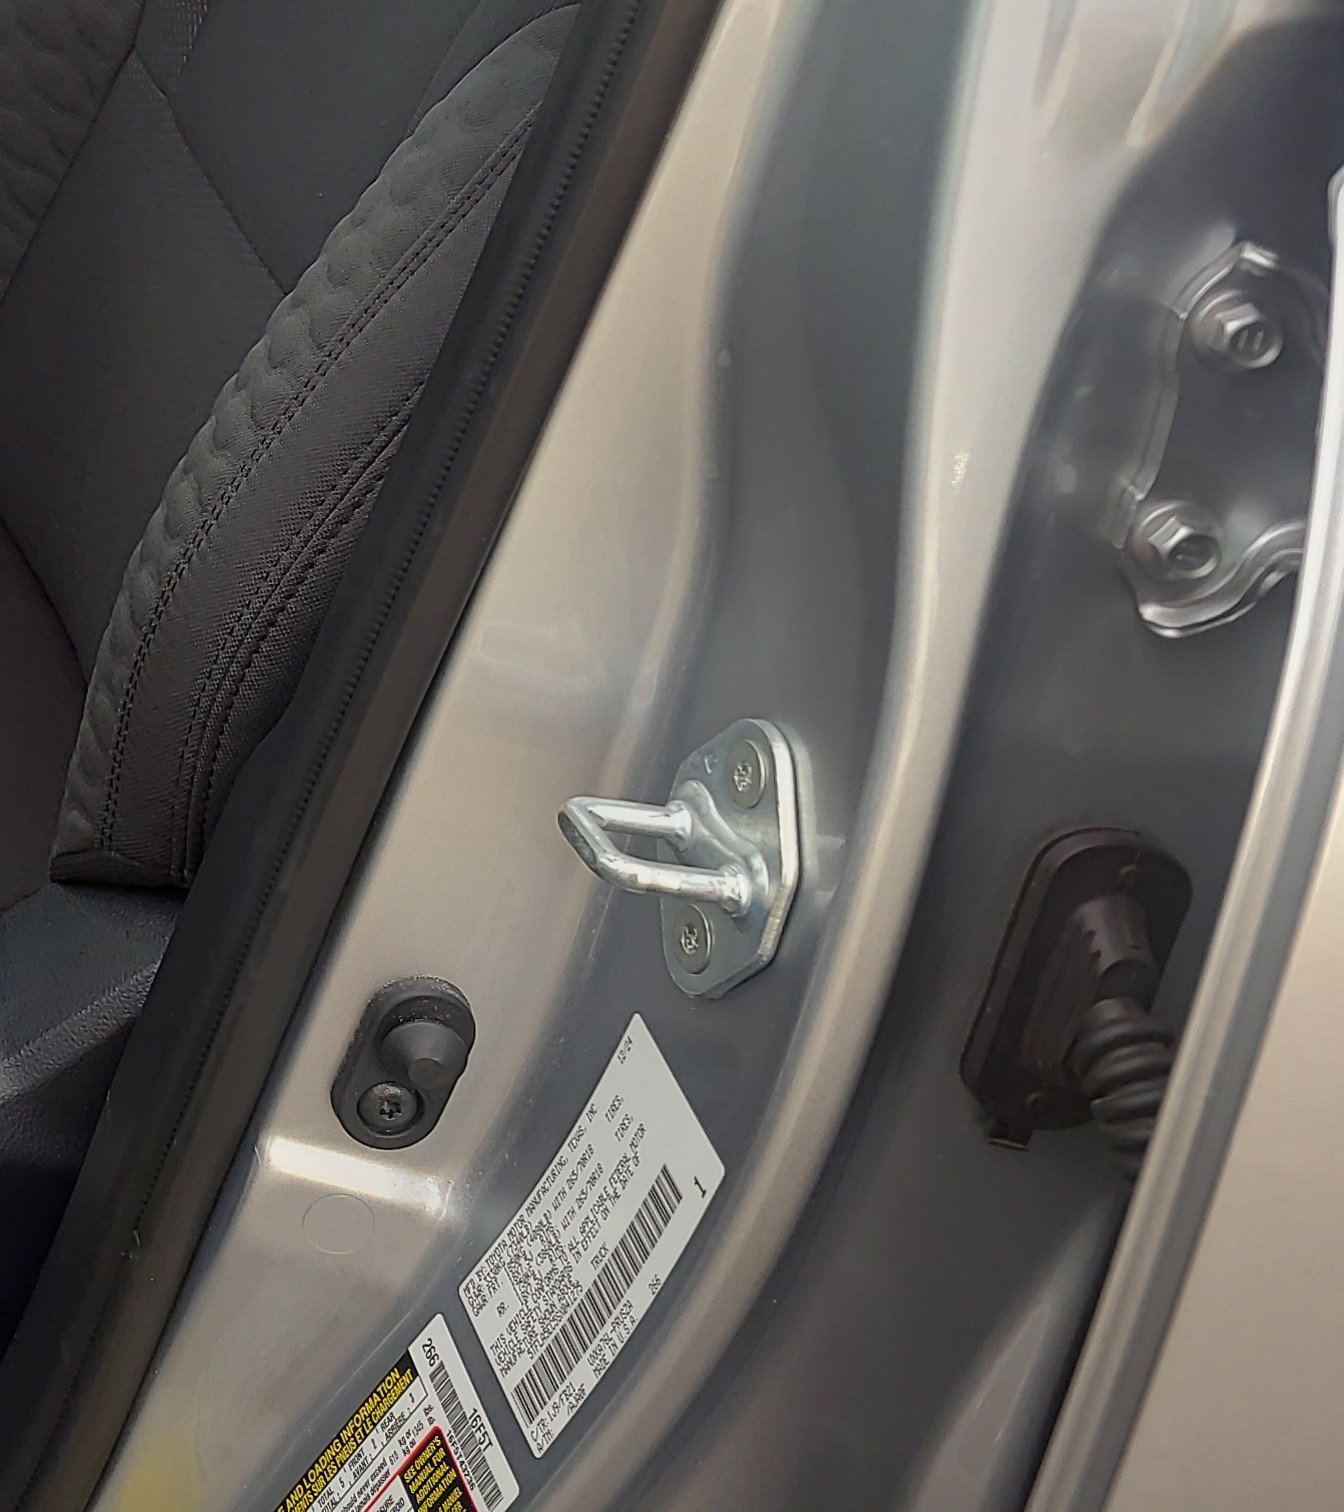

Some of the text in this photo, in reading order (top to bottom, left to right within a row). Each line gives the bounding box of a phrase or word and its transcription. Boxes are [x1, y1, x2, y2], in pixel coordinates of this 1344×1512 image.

[551, 1186, 568, 1212] WITH
[566, 1144, 594, 1190] 265/70R18
[605, 1094, 624, 1123] TIRES,
[560, 1205, 577, 1231] WITH
[575, 1163, 604, 1210] 265/70R18
[614, 1113, 634, 1142] TIRES,
[489, 1123, 647, 1359] THIS VEHICLE CONFORMS TO ALL APPLICABLE FEDERAL MOTOR
[494, 1328, 521, 1371] VEHICLE
[520, 1301, 543, 1338] SAFETY
[542, 1259, 573, 1307] STANDARDS
[579, 1216, 601, 1252] EFFECT
[598, 1203, 611, 1221] ON
[606, 1186, 622, 1207] THE
[617, 1164, 635, 1191] DATE
[590, 1242, 609, 1271] TRUCK
[421, 1337, 441, 1368] 266
[499, 1274, 576, 1378] MANUFACTURE SHOWN ABOVE
[592, 1353, 610, 1379] MADE
[607, 1338, 619, 1357] IN
[648, 1273, 662, 1296] 266
[286, 1484, 304, 1509] AND
[302, 1438, 342, 1489] LOADING
[340, 1367, 402, 1443] INFORMATION
[311, 1475, 327, 1497] SUR
[323, 1461, 338, 1482] LES
[334, 1438, 357, 1468] PNEUS
[371, 1368, 415, 1425] CHARGEMENT
[318, 1486, 335, 1508] TOTAL
[348, 1447, 366, 1471] FRONT
[380, 1411, 397, 1433] REAR
[403, 1464, 418, 1484] SEE
[414, 1434, 443, 1470] OWNER'S
[408, 1462, 435, 1494] MANUAL
[430, 1447, 447, 1467] FOR
[467, 1406, 494, 1454] 16F5T
[415, 1461, 450, 1505] ADDITIONAL
